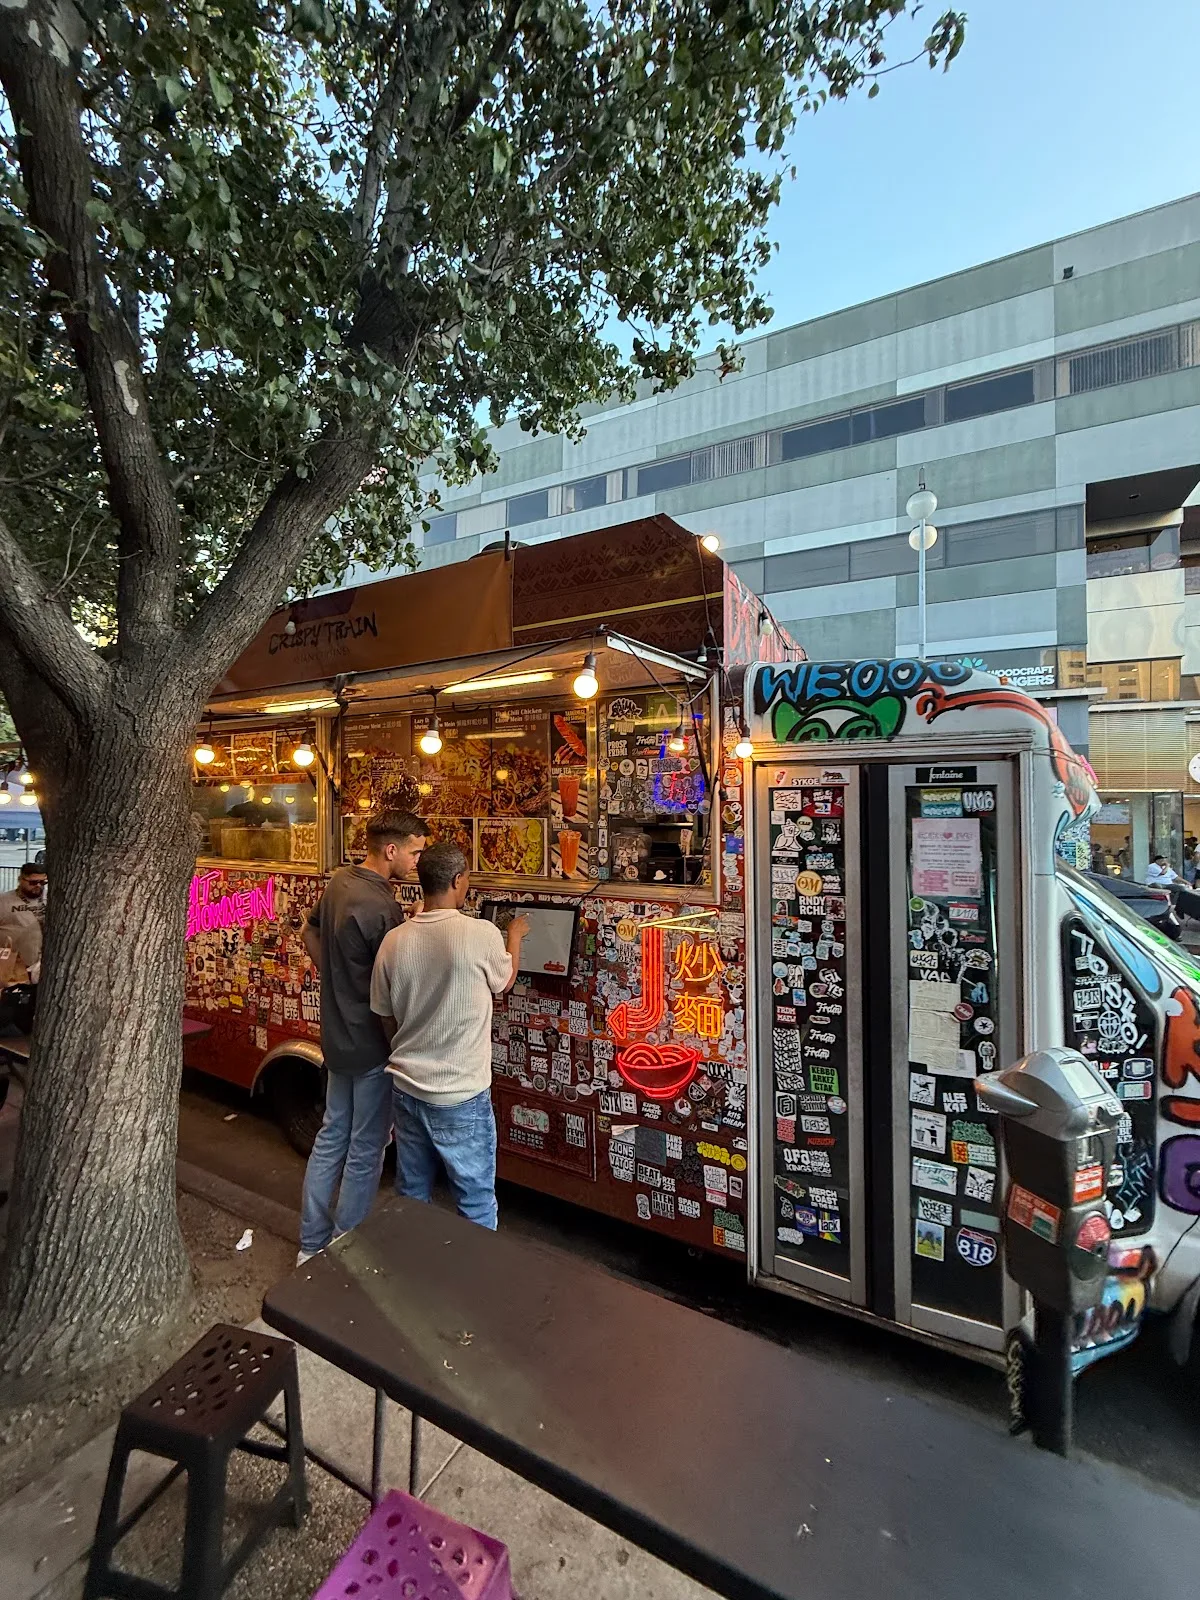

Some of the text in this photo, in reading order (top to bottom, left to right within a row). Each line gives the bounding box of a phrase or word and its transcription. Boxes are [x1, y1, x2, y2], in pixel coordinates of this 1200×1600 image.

[324, 611, 378, 643] TRAIN
[1007, 675, 1055, 687] NGERS
[799, 896, 825, 906] RNDY
[799, 905, 826, 916] RCHL
[808, 1186, 838, 1198] MERCH
[810, 1195, 838, 1205] TOAST
[958, 1238, 993, 1264] 818
